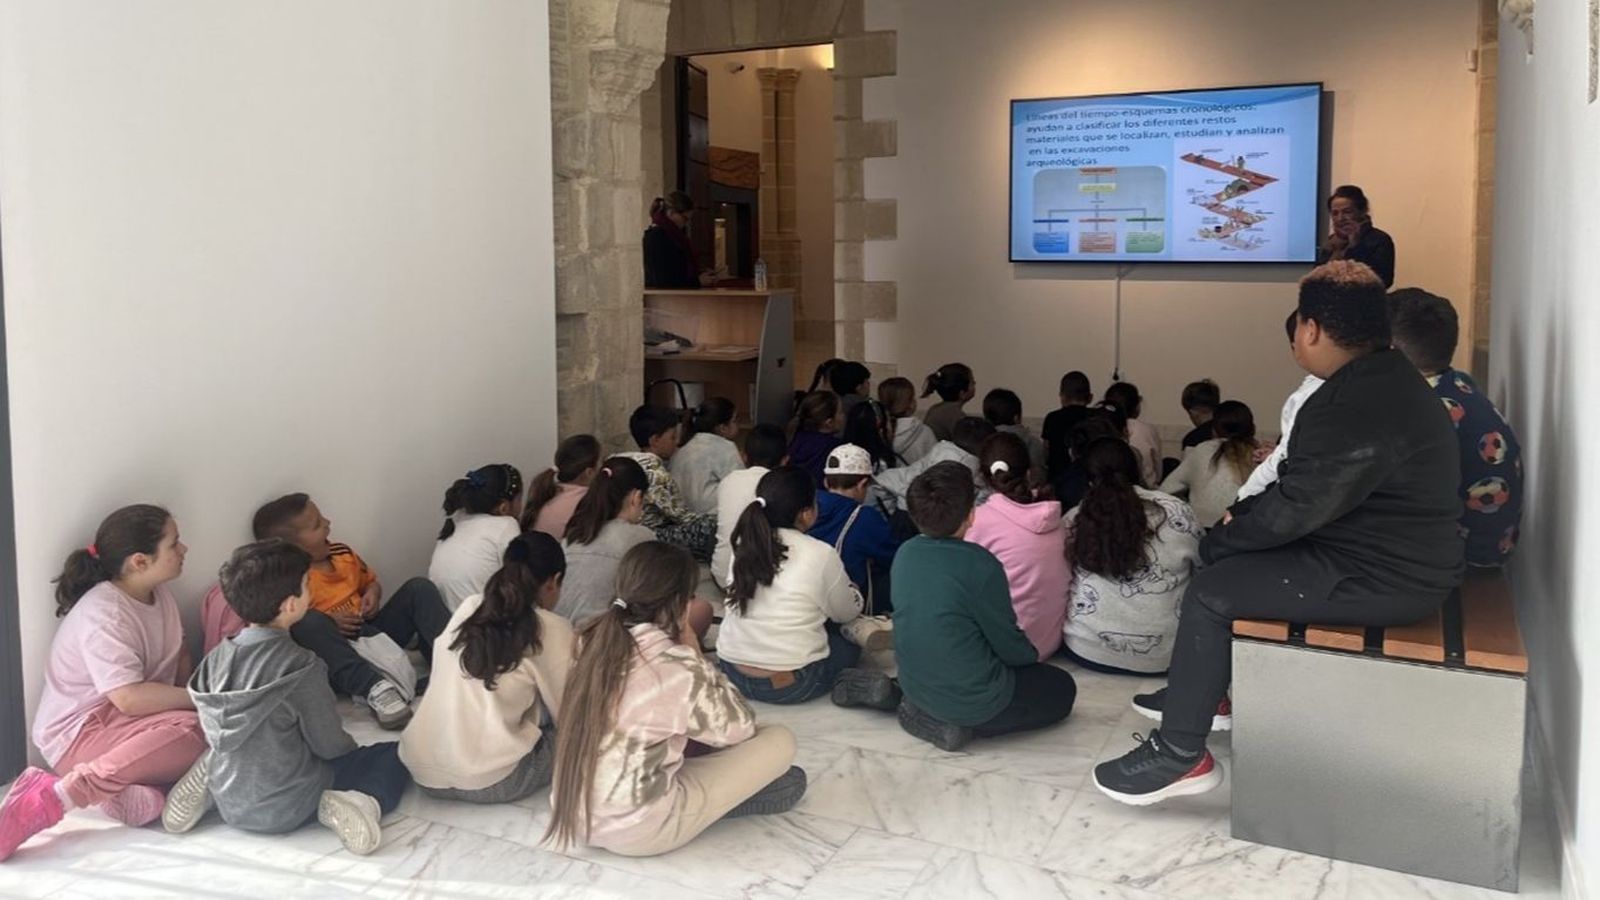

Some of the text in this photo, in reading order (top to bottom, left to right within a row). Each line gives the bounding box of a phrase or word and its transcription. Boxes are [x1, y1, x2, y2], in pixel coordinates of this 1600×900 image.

[1061, 110, 1078, 120] del
[1026, 123, 1064, 134] ayudan
[1075, 120, 1121, 131] clasificar
[1124, 119, 1140, 129] los
[1143, 117, 1199, 128] diferentes
[1202, 115, 1237, 125] restos
[1026, 134, 1080, 144] materiales
[1082, 133, 1104, 143] que
[1106, 133, 1118, 141] se
[1174, 127, 1223, 139] estudian
[1226, 128, 1233, 137] y
[1235, 125, 1285, 136] analizan
[1028, 144, 1130, 156] en las excavaciones
[1026, 156, 1097, 168] arqueológicas
